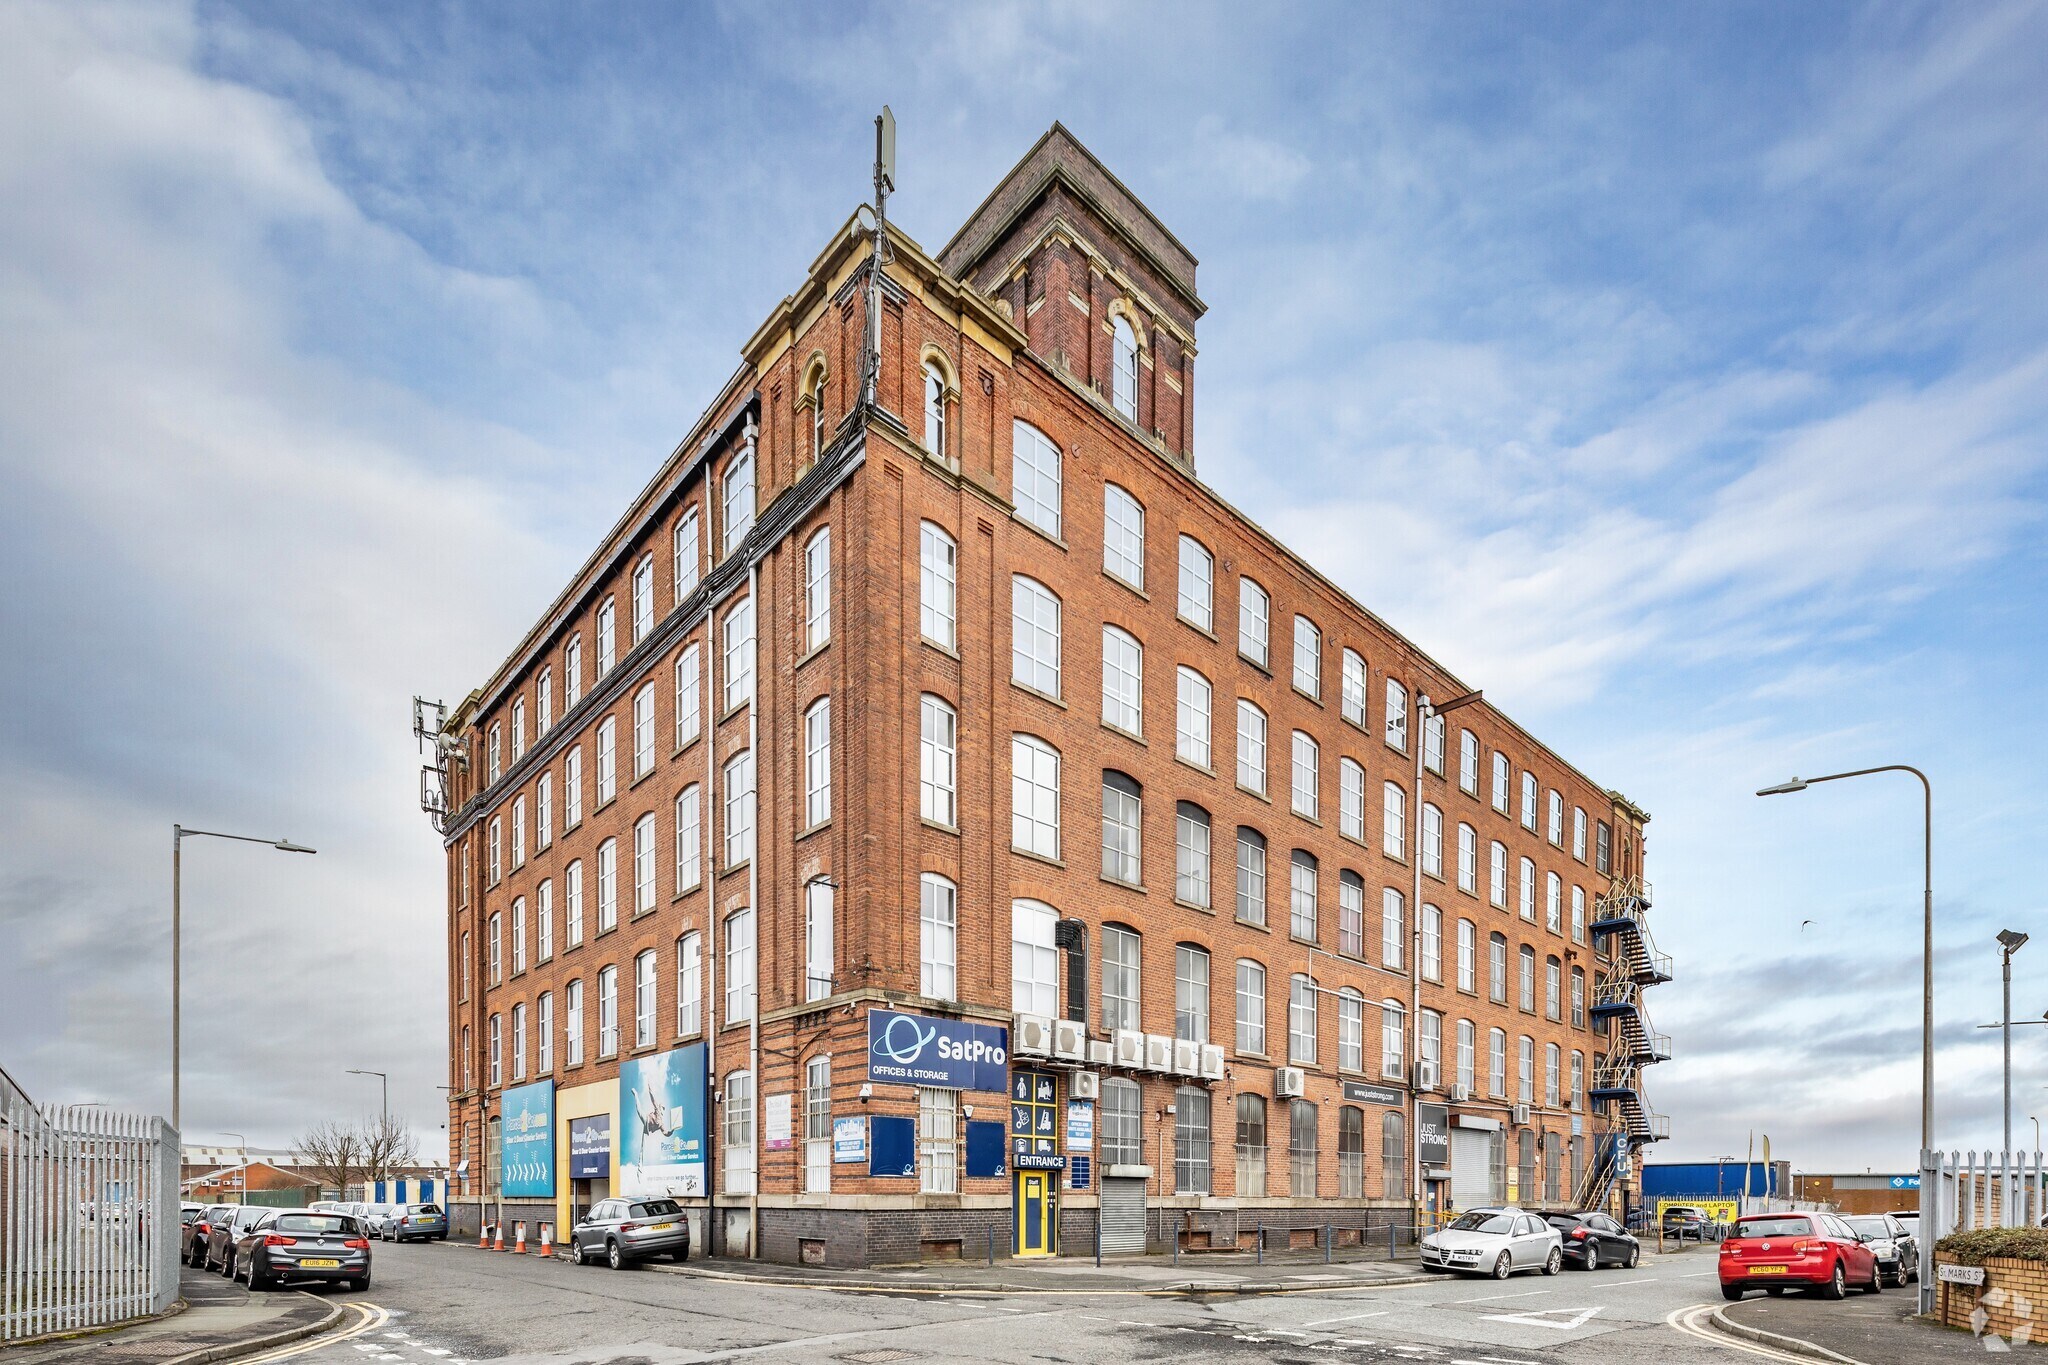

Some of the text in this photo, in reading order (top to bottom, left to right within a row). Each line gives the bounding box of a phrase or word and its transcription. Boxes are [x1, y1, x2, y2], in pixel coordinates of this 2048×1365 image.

[937, 1035, 1006, 1066] SatPro
[873, 1065, 949, 1081] OFFICES & STORAGE
[1354, 1089, 1394, 1101] www.juststrong.com
[1421, 1123, 1436, 1134] JUST
[1421, 1134, 1447, 1145] STRONG
[1020, 1155, 1064, 1167] ENTRANCE
[1948, 1268, 1971, 1280] MARKS
